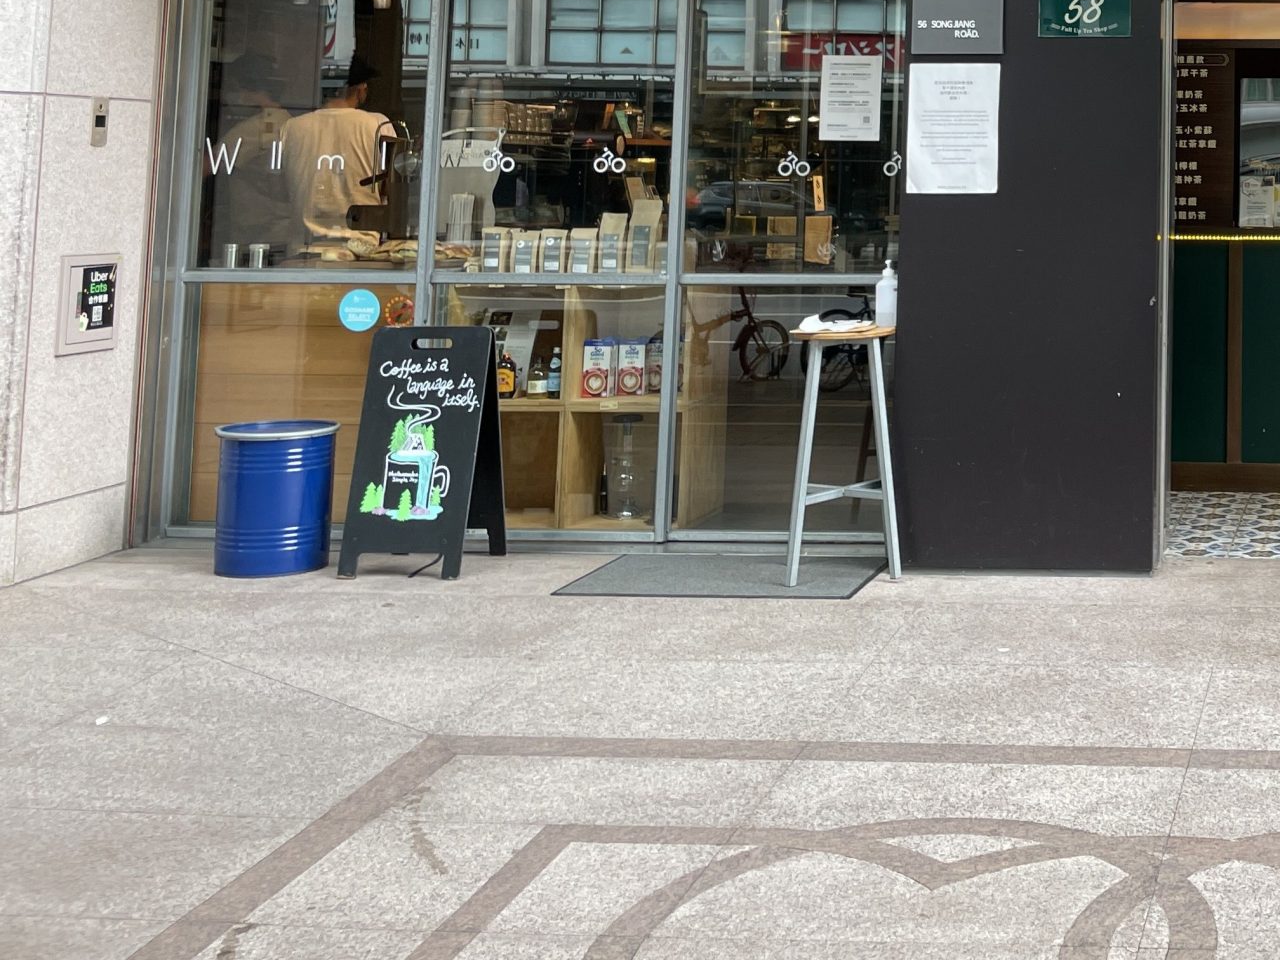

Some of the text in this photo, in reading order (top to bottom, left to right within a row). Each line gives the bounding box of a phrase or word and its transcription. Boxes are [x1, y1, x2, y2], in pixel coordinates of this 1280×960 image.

[917, 20, 927, 28] 56
[1175, 140, 1217, 148] 紅茶拿鐵
[90, 271, 109, 282] Uber
[90, 283, 108, 293] Eats
[380, 358, 449, 378] Coffee is a
[407, 373, 475, 399] language in
